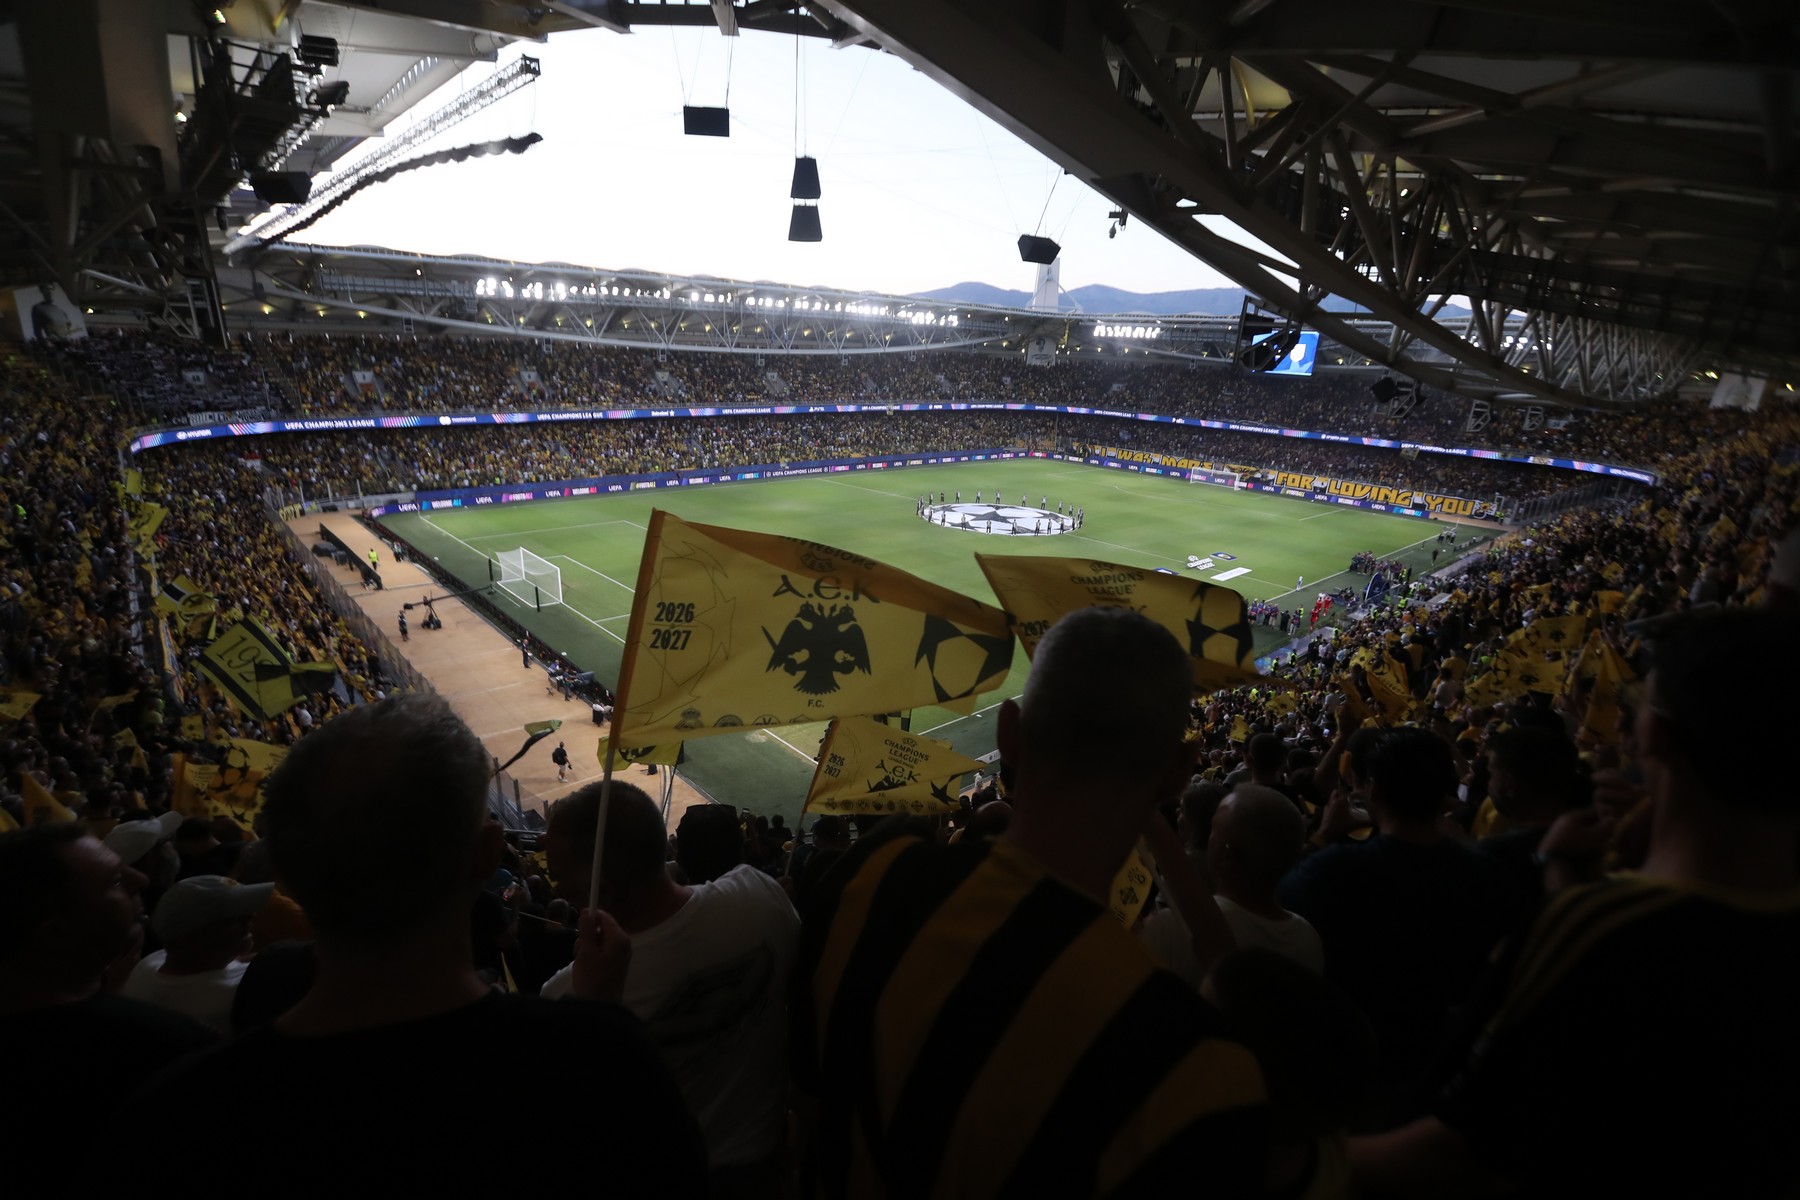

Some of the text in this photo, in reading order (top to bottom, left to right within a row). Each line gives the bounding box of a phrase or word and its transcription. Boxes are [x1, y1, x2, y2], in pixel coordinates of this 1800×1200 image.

[285, 422, 304, 430] UEFA
[349, 419, 375, 428] LEAGUE
[546, 490, 560, 498] UEFA
[608, 484, 622, 492] UEFA
[1276, 472, 1313, 490] FOR
[1328, 481, 1412, 507] LOVING
[1425, 496, 1474, 516] YOU
[476, 496, 492, 504] UEFA
[398, 503, 417, 512] UEFA
[1070, 571, 1144, 586] CHAMPIONS
[1085, 583, 1133, 596] LEAGUE
[654, 601, 696, 623] 2026
[649, 628, 693, 651] 2027
[807, 699, 825, 708] F.C.
[884, 739, 930, 761] CHAMPIONS
[889, 749, 922, 765] LEAGUE
[829, 753, 846, 767] 2026
[824, 764, 843, 779] 2027
